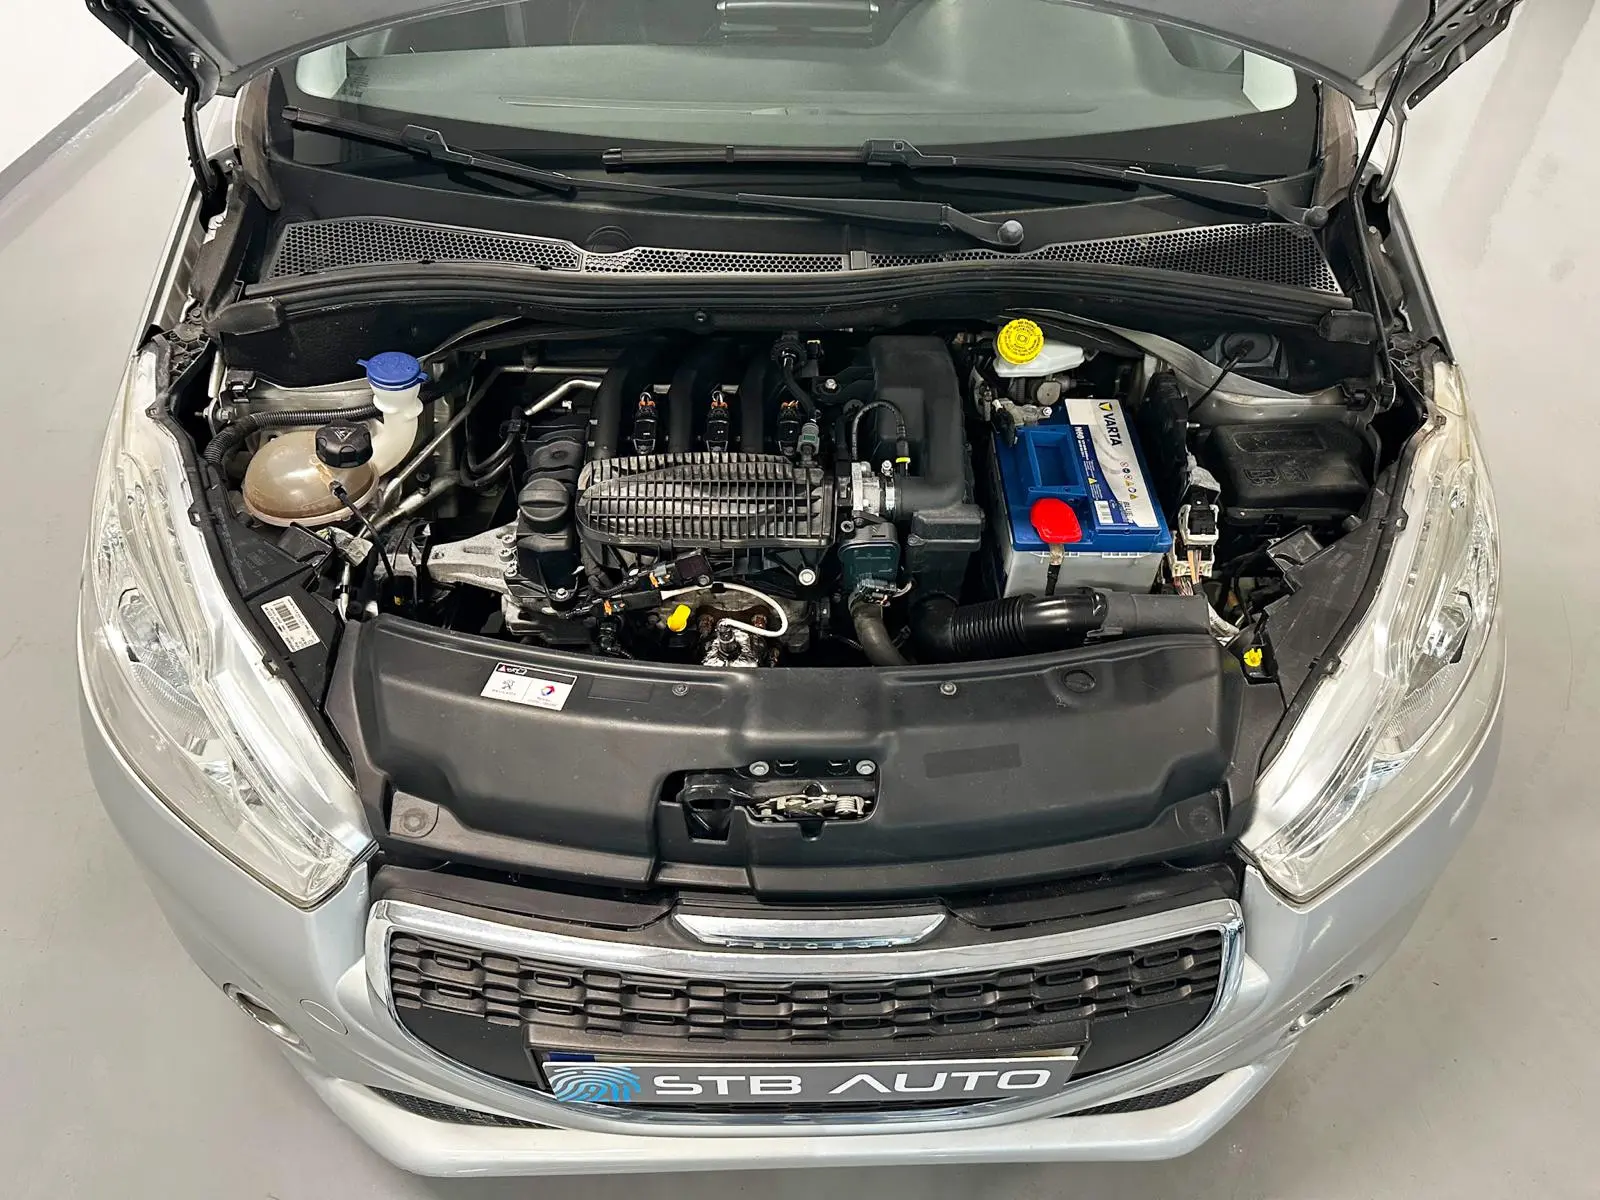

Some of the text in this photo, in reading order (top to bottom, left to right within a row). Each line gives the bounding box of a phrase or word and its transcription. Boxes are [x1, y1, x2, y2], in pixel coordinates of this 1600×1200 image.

[1103, 412, 1122, 446] VARTA
[653, 1069, 1051, 1095] STB AUTO
